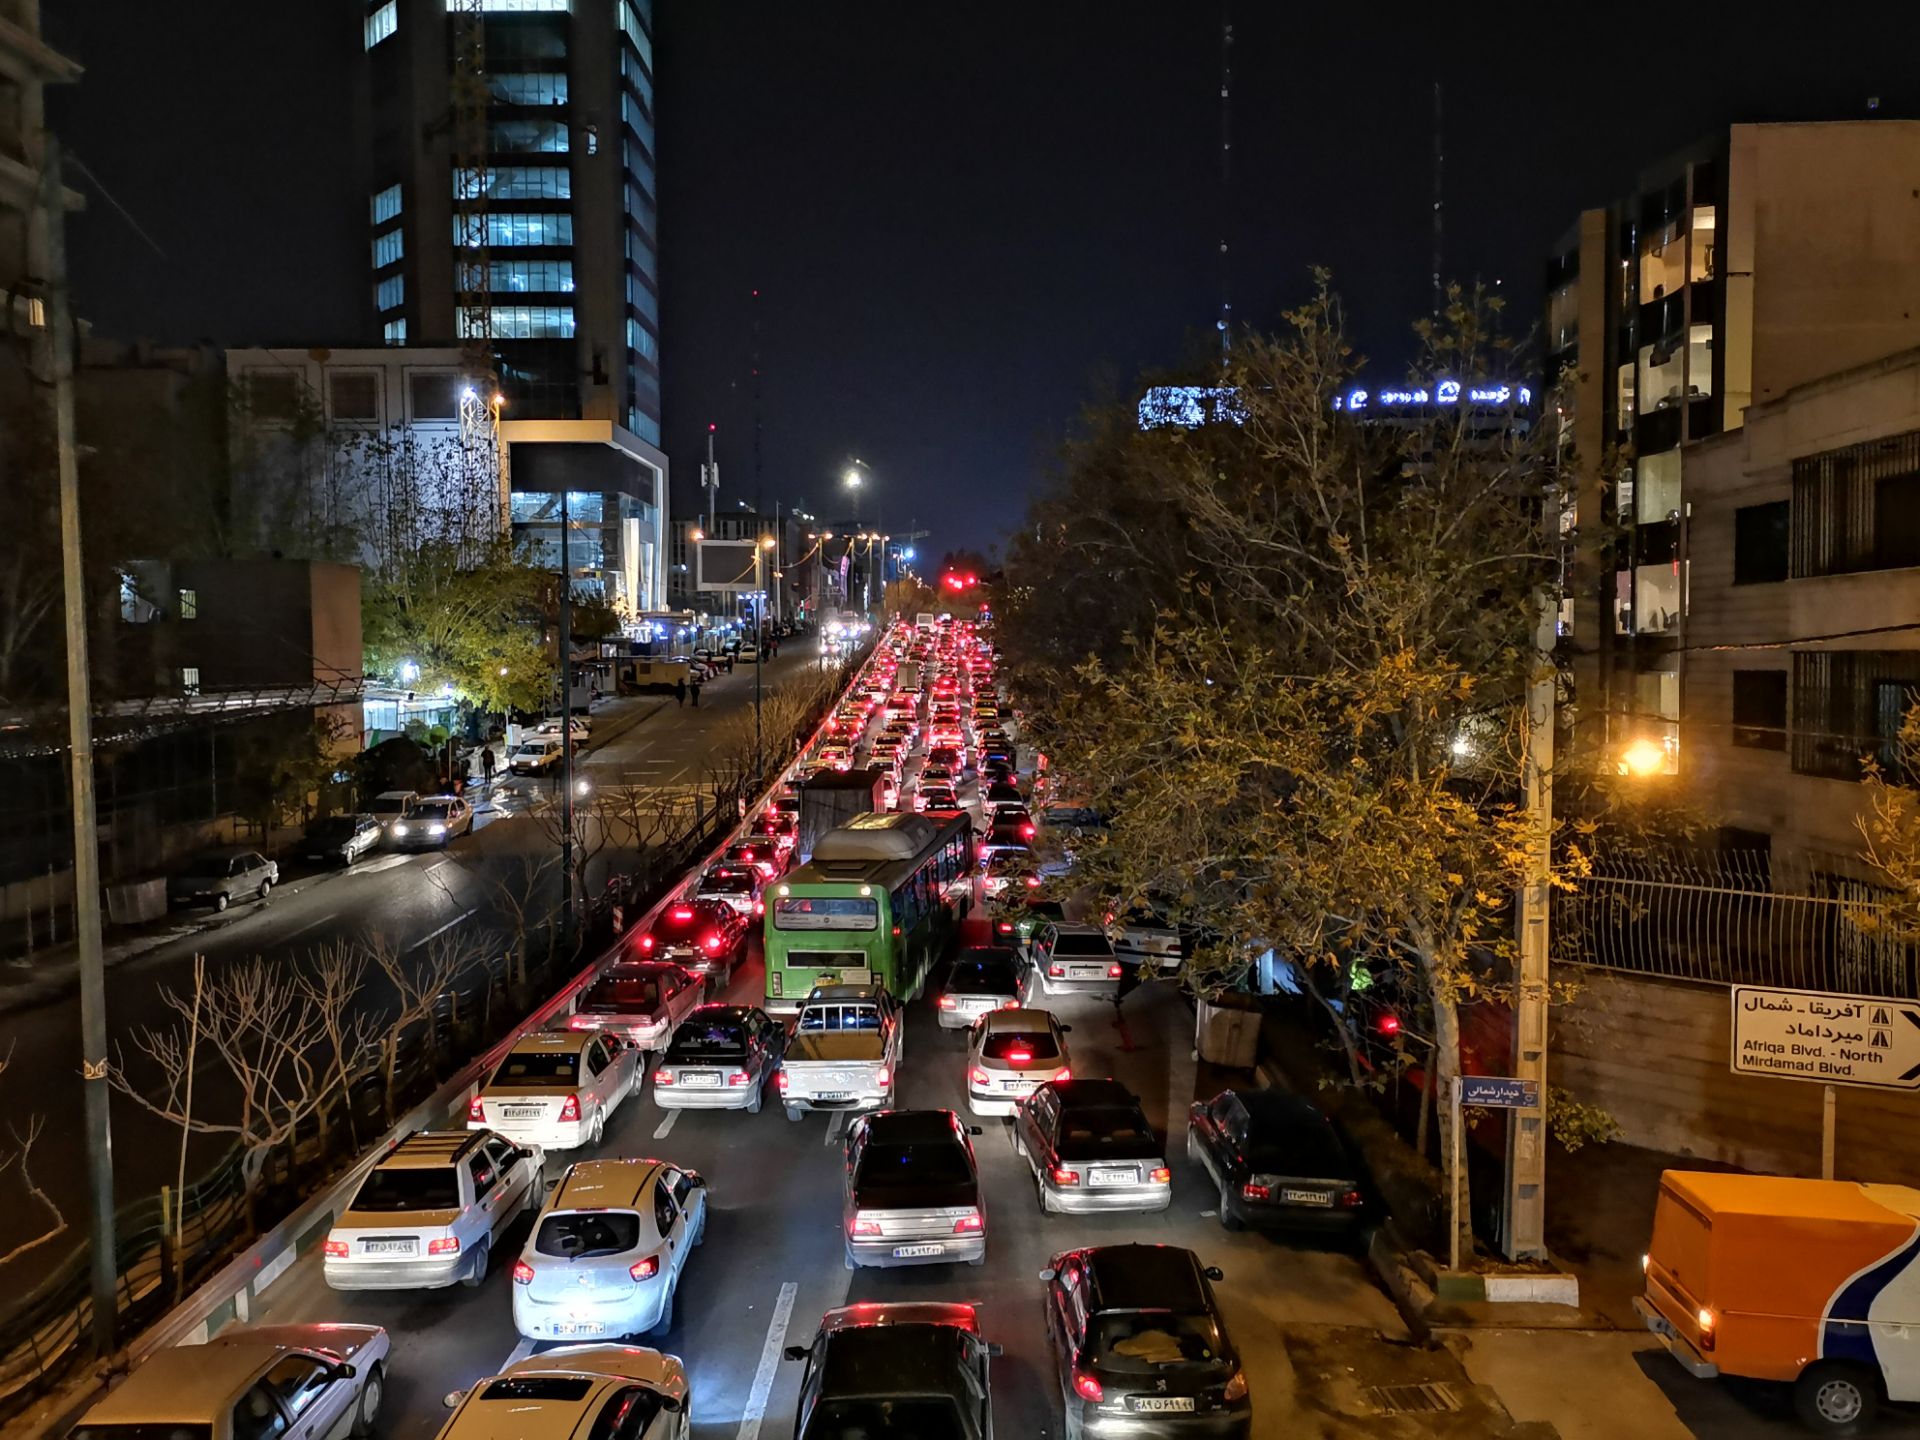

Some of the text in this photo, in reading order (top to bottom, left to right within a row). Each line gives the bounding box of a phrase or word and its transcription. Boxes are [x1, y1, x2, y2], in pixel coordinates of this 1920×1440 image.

[1745, 997, 1793, 1012] شمال
[1809, 1002, 1864, 1020] آفریقا
[1785, 1023, 1863, 1043] میرداماد
[1743, 1040, 1785, 1054] Afriqa
[1791, 1044, 1826, 1058] Blvd.
[1840, 1049, 1883, 1064] North
[1743, 1055, 1855, 1076] Mirdamad Blvd.
